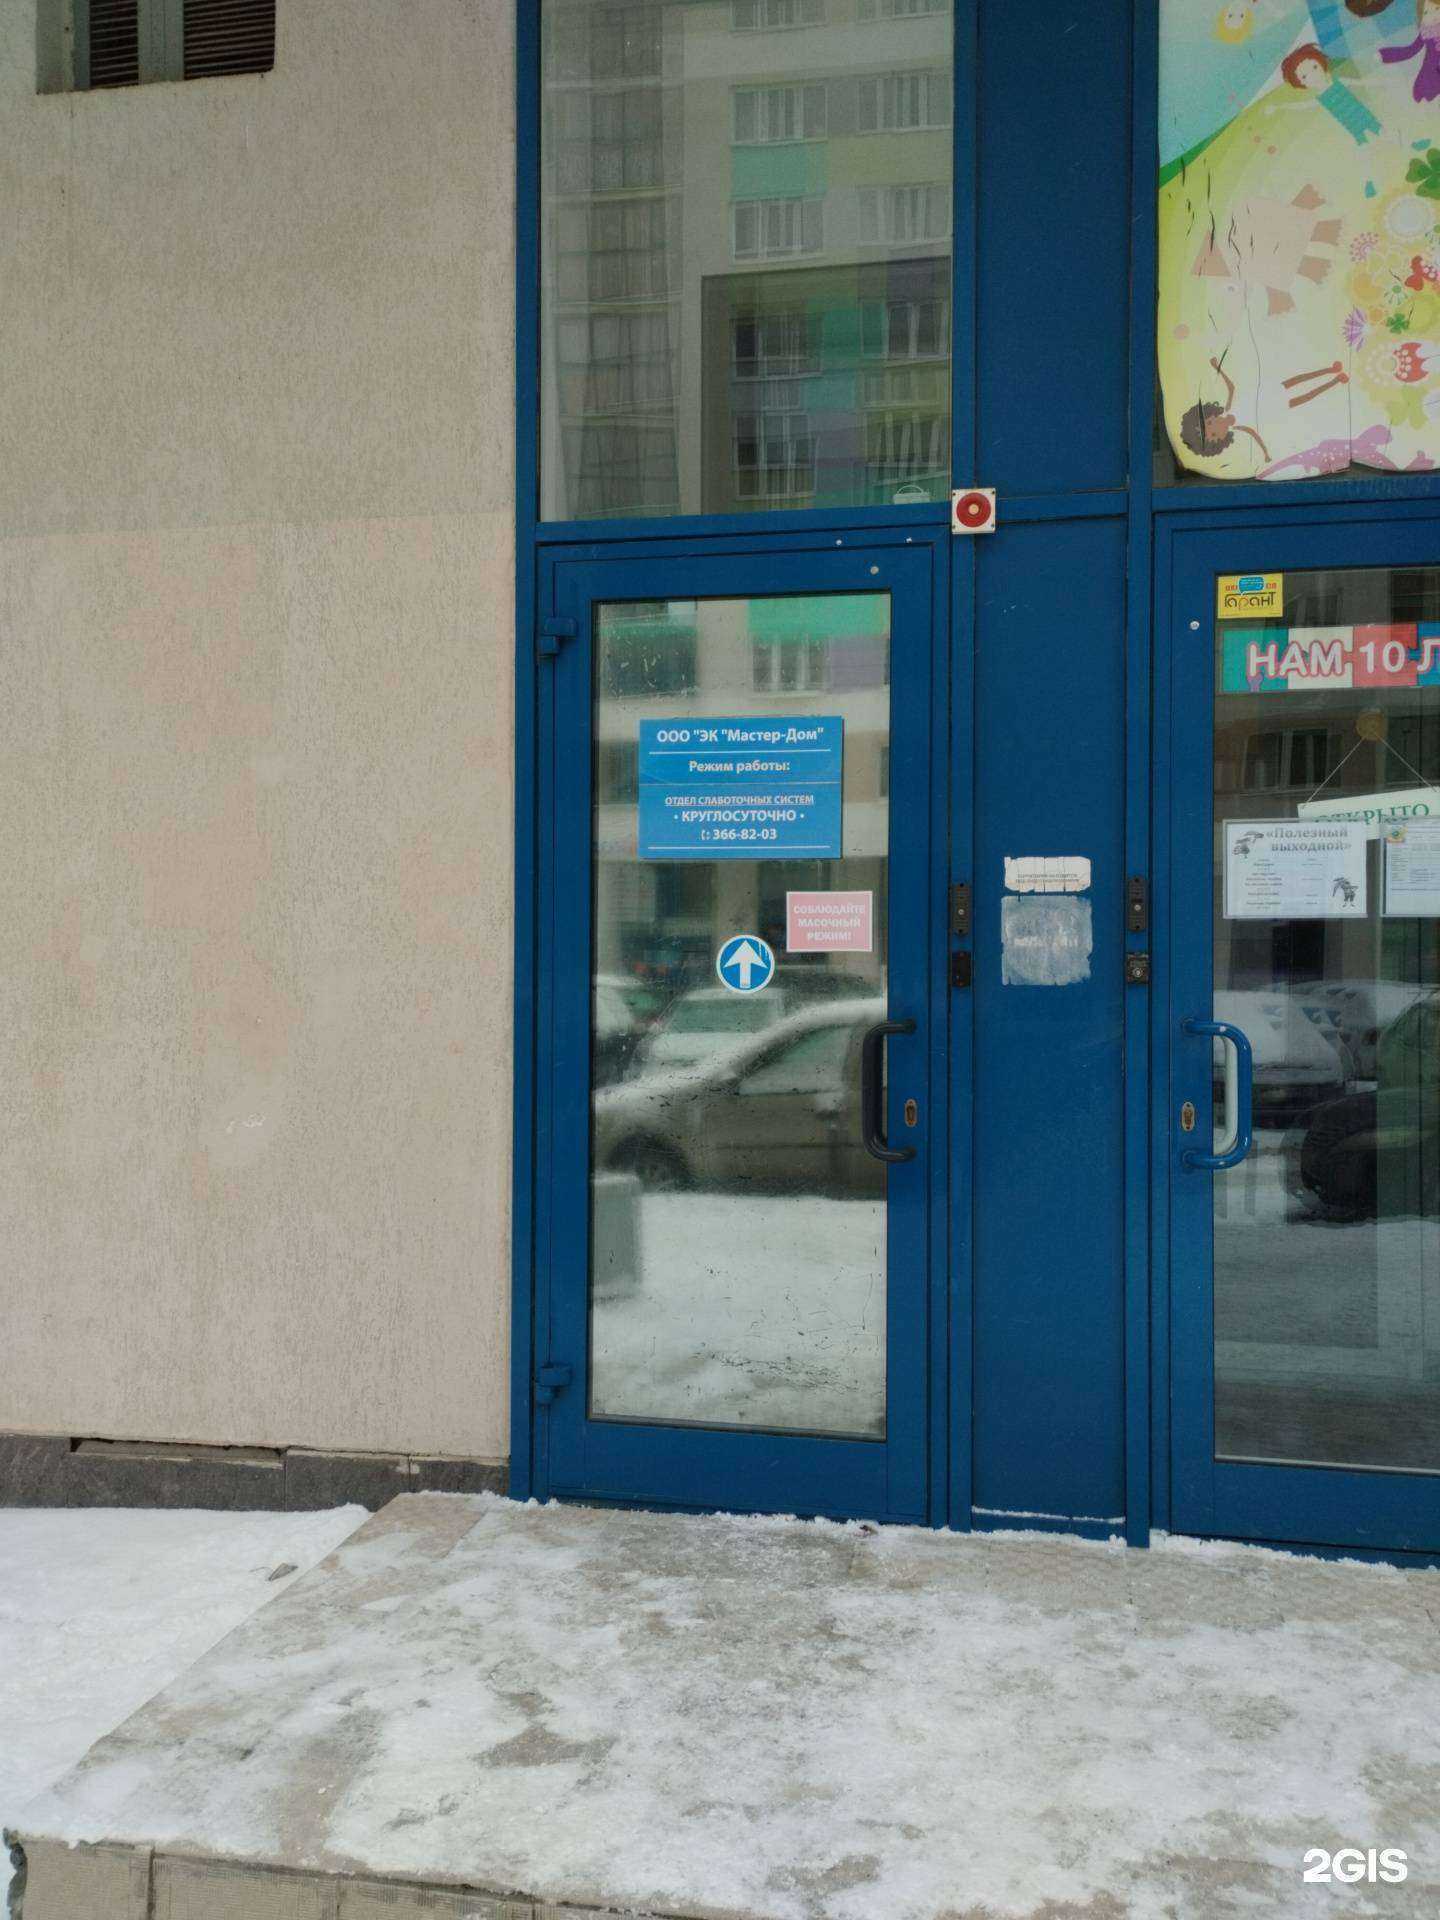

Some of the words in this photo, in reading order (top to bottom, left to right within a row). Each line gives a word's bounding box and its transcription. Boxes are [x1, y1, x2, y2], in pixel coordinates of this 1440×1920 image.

[1248, 640, 1343, 677] НАМ
[1359, 640, 1406, 674] 10
[656, 730, 690, 742] ООО
[693, 729, 719, 742] "ЭК
[721, 727, 824, 743] "Мастер-Дом"
[689, 760, 734, 772] Режим
[736, 760, 791, 774] работы:
[664, 796, 697, 805] ОТДЕЛ
[698, 796, 772, 805] СЛАБОТОЧНЫХ
[774, 795, 814, 804] СИСТЕМ
[681, 810, 796, 822] КРУГЛОСУТОЧНО
[1314, 803, 1430, 826] РЫТО
[713, 828, 777, 840] 366-82-03
[793, 903, 865, 915] СОБЛЮДАЙТЕ
[798, 917, 861, 928] МАСОЧНЫЙ
